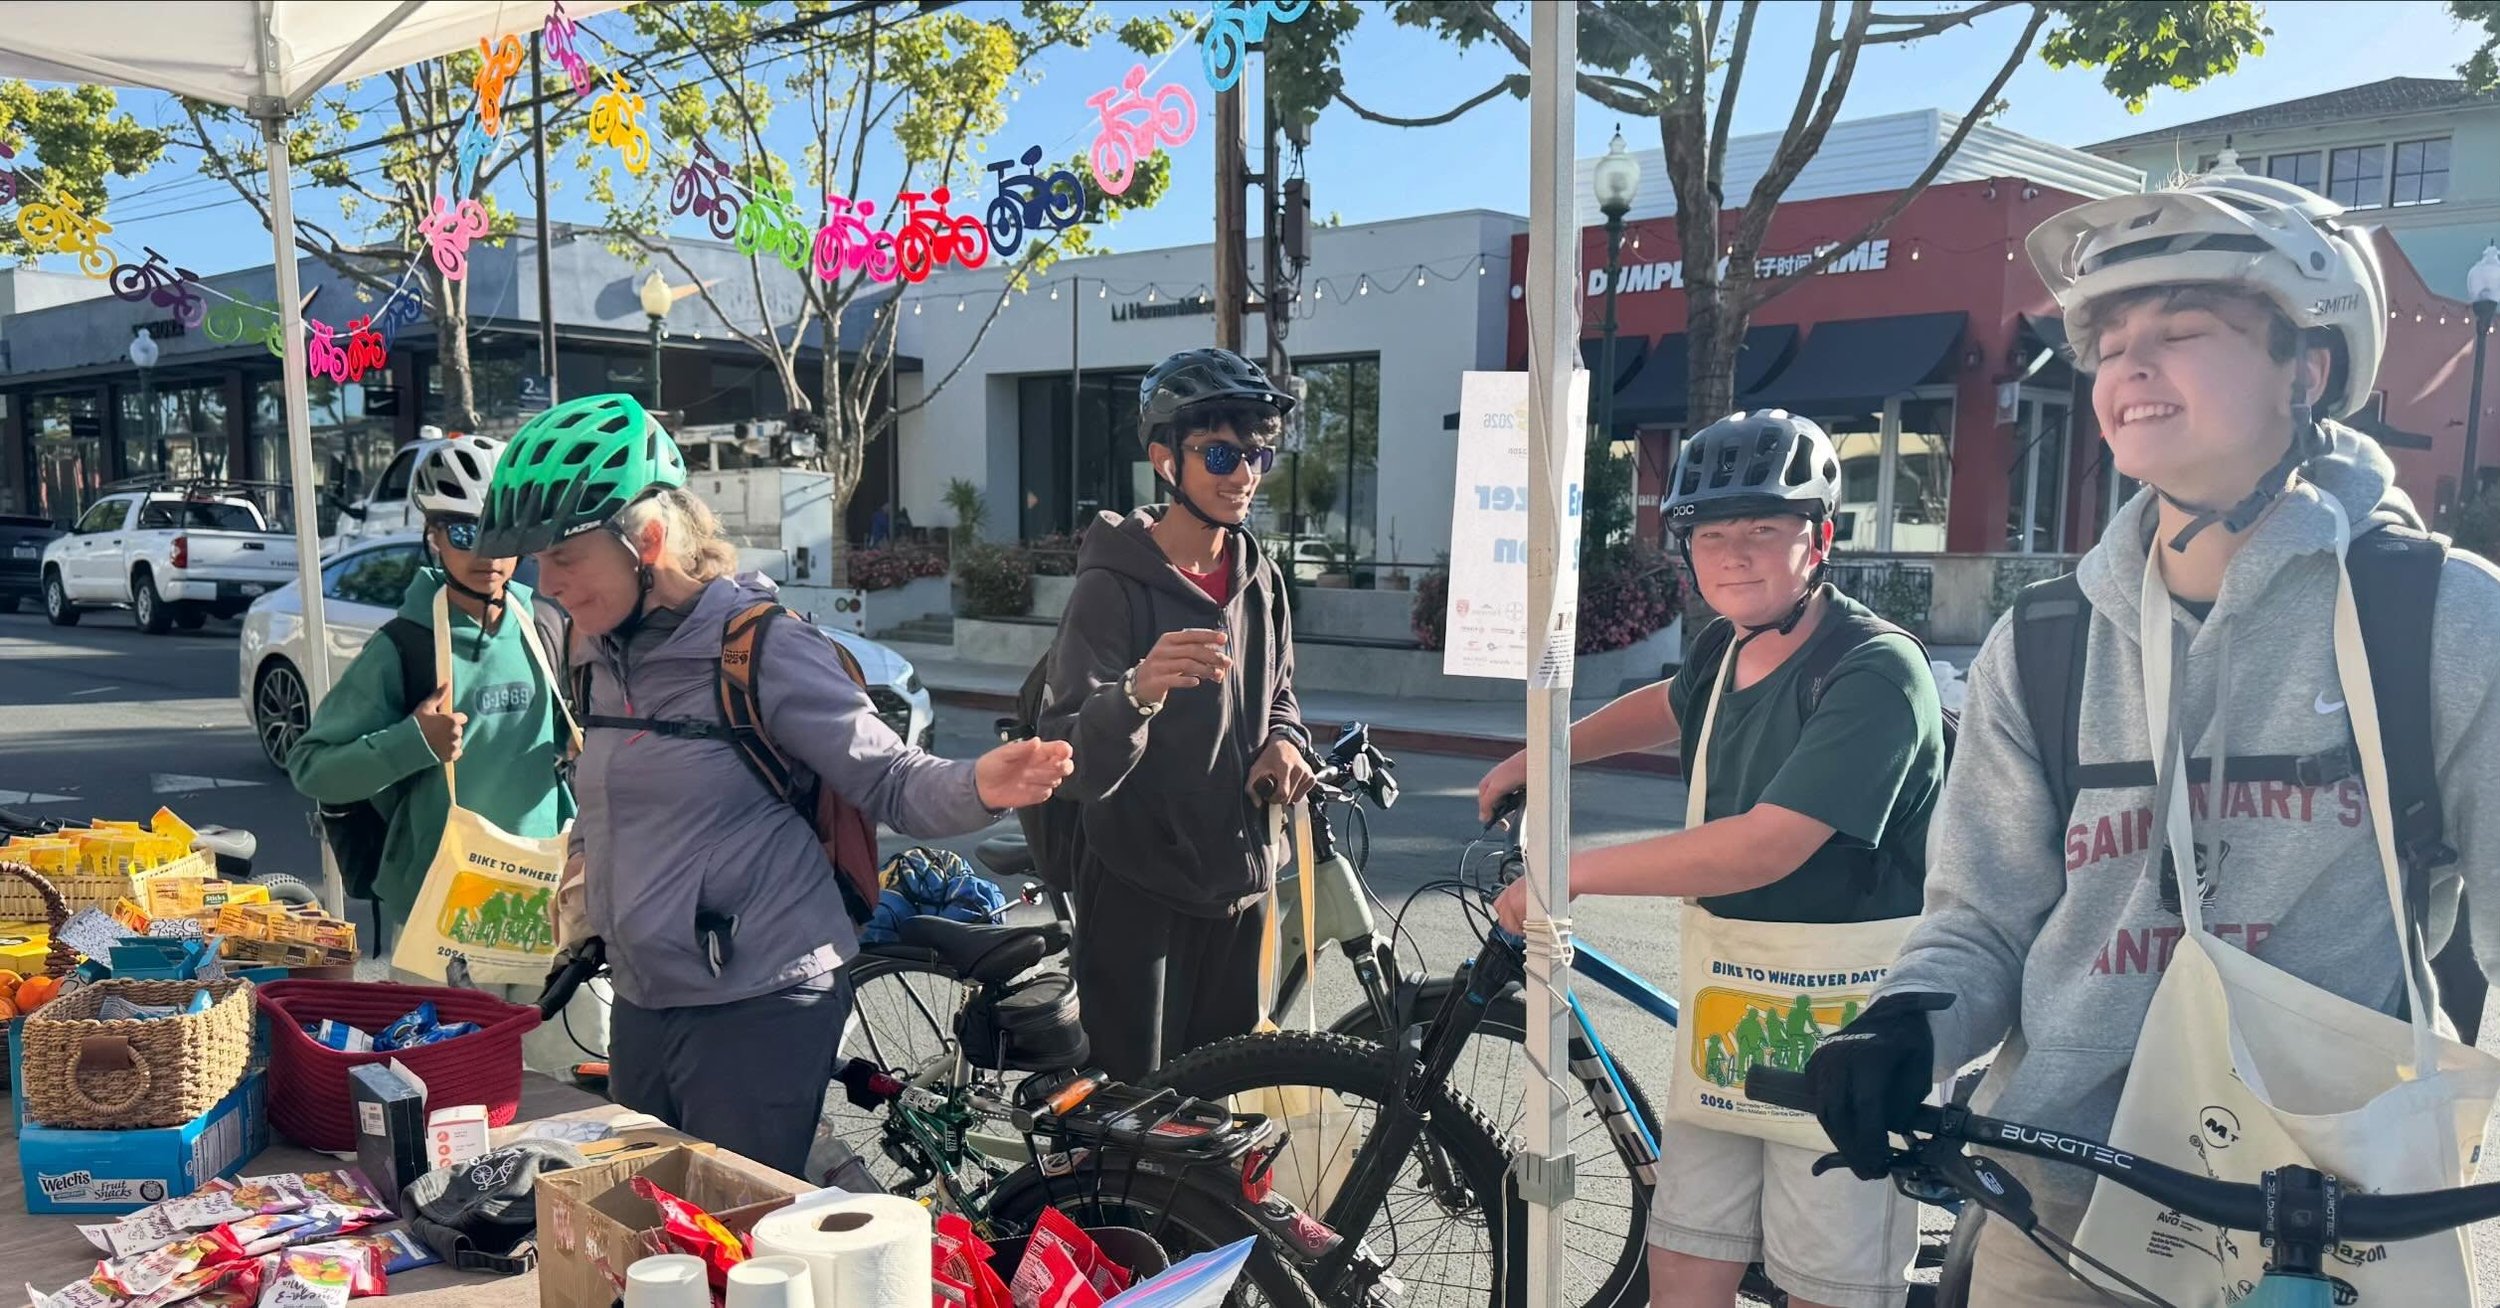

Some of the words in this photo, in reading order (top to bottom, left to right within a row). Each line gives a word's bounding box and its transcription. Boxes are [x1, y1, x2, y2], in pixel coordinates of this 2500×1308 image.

[2315, 294, 2359, 315] SMITH
[468, 852, 496, 869] BIKE
[499, 861, 517, 873] TO
[519, 866, 559, 883] WHERE
[1712, 960, 1743, 978] BIKE
[1745, 967, 1766, 981] TO
[1768, 970, 1847, 988] WHEREVER
[1700, 1093, 1734, 1111] 2026
[2001, 1124, 2134, 1169] BURGTEC
[40, 1171, 92, 1193] Welch's
[101, 1180, 127, 1191] Fruit
[94, 1187, 133, 1199] Snacks
